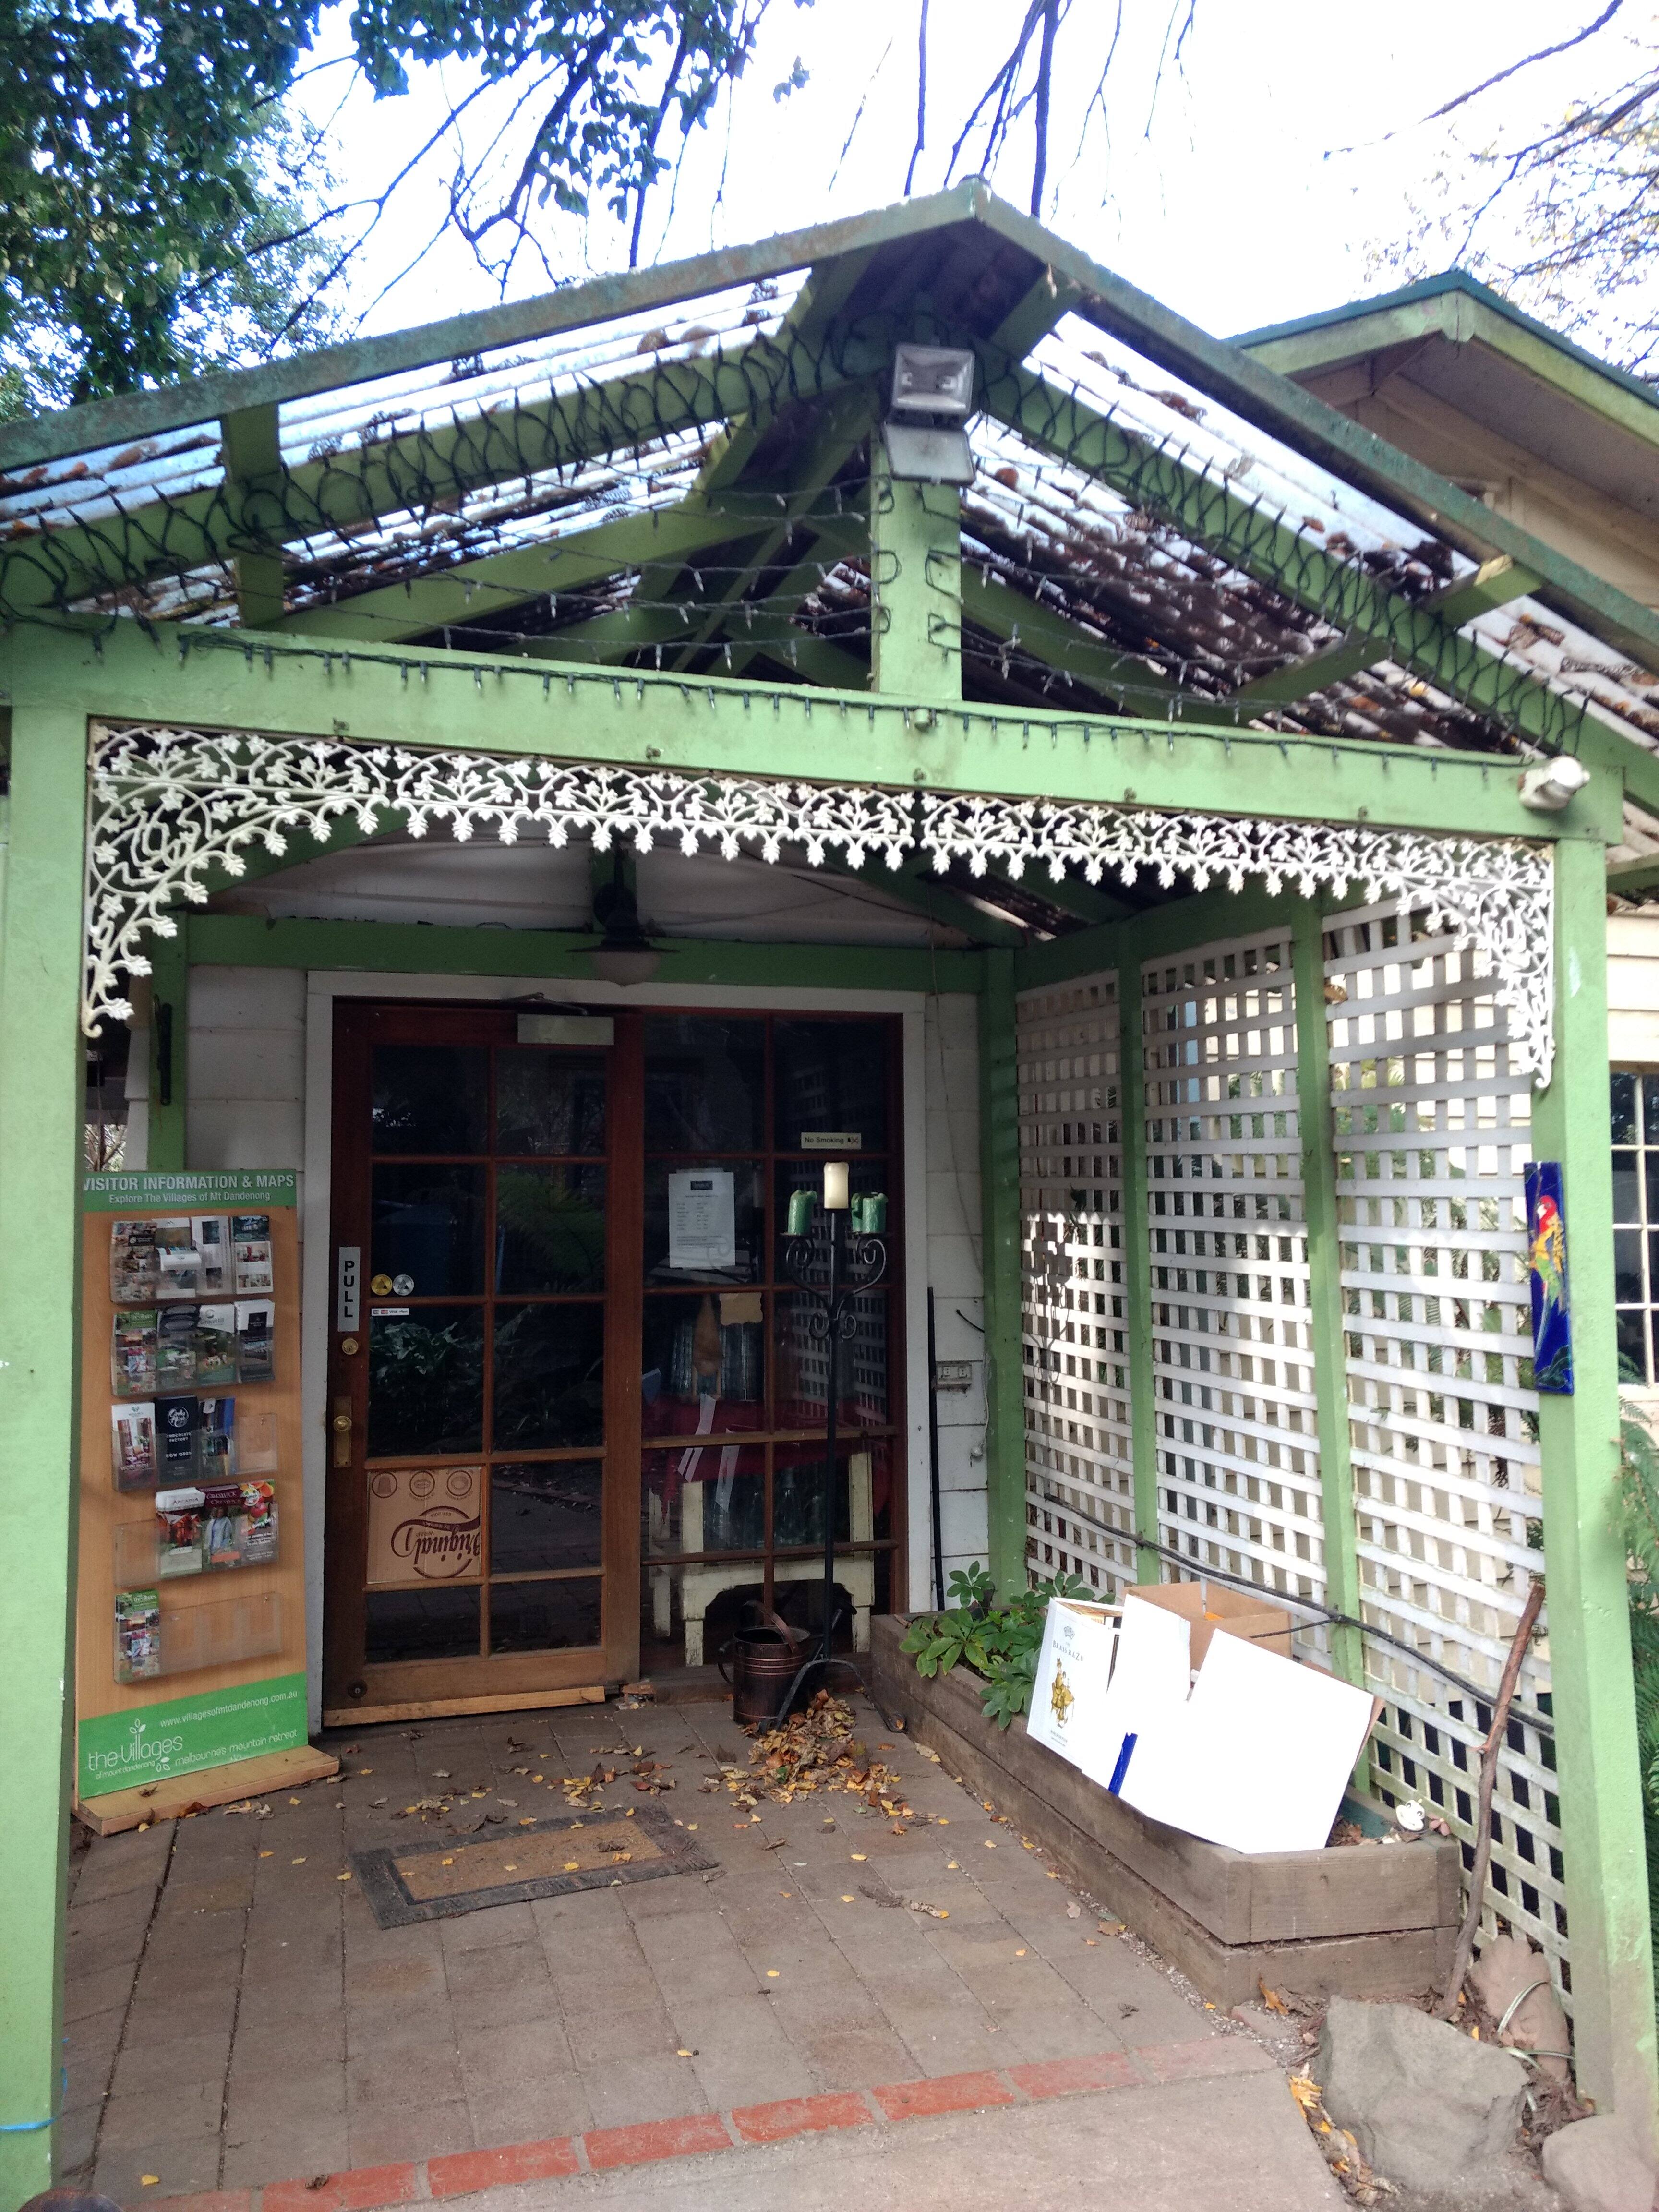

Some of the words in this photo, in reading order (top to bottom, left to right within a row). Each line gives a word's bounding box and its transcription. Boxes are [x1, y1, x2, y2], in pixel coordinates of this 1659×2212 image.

[144, 1175, 238, 1190] INFORMATION
[242, 1175, 252, 1188] &
[257, 1174, 294, 1188] MAPS
[109, 1194, 143, 1205] Explore
[145, 1193, 161, 1202] The
[163, 1192, 197, 1203] Villages
[199, 1192, 208, 1201] of
[210, 1192, 221, 1201] Mt
[224, 1191, 270, 1201] Dandenong
[344, 1261, 355, 1317] PULL
[1052, 1640, 1068, 1654] BRASS
[160, 1690, 298, 1728] www.villagesofmtdandenong.com.au
[229, 1736, 267, 1753] mountain
[269, 1729, 298, 1743] retreat
